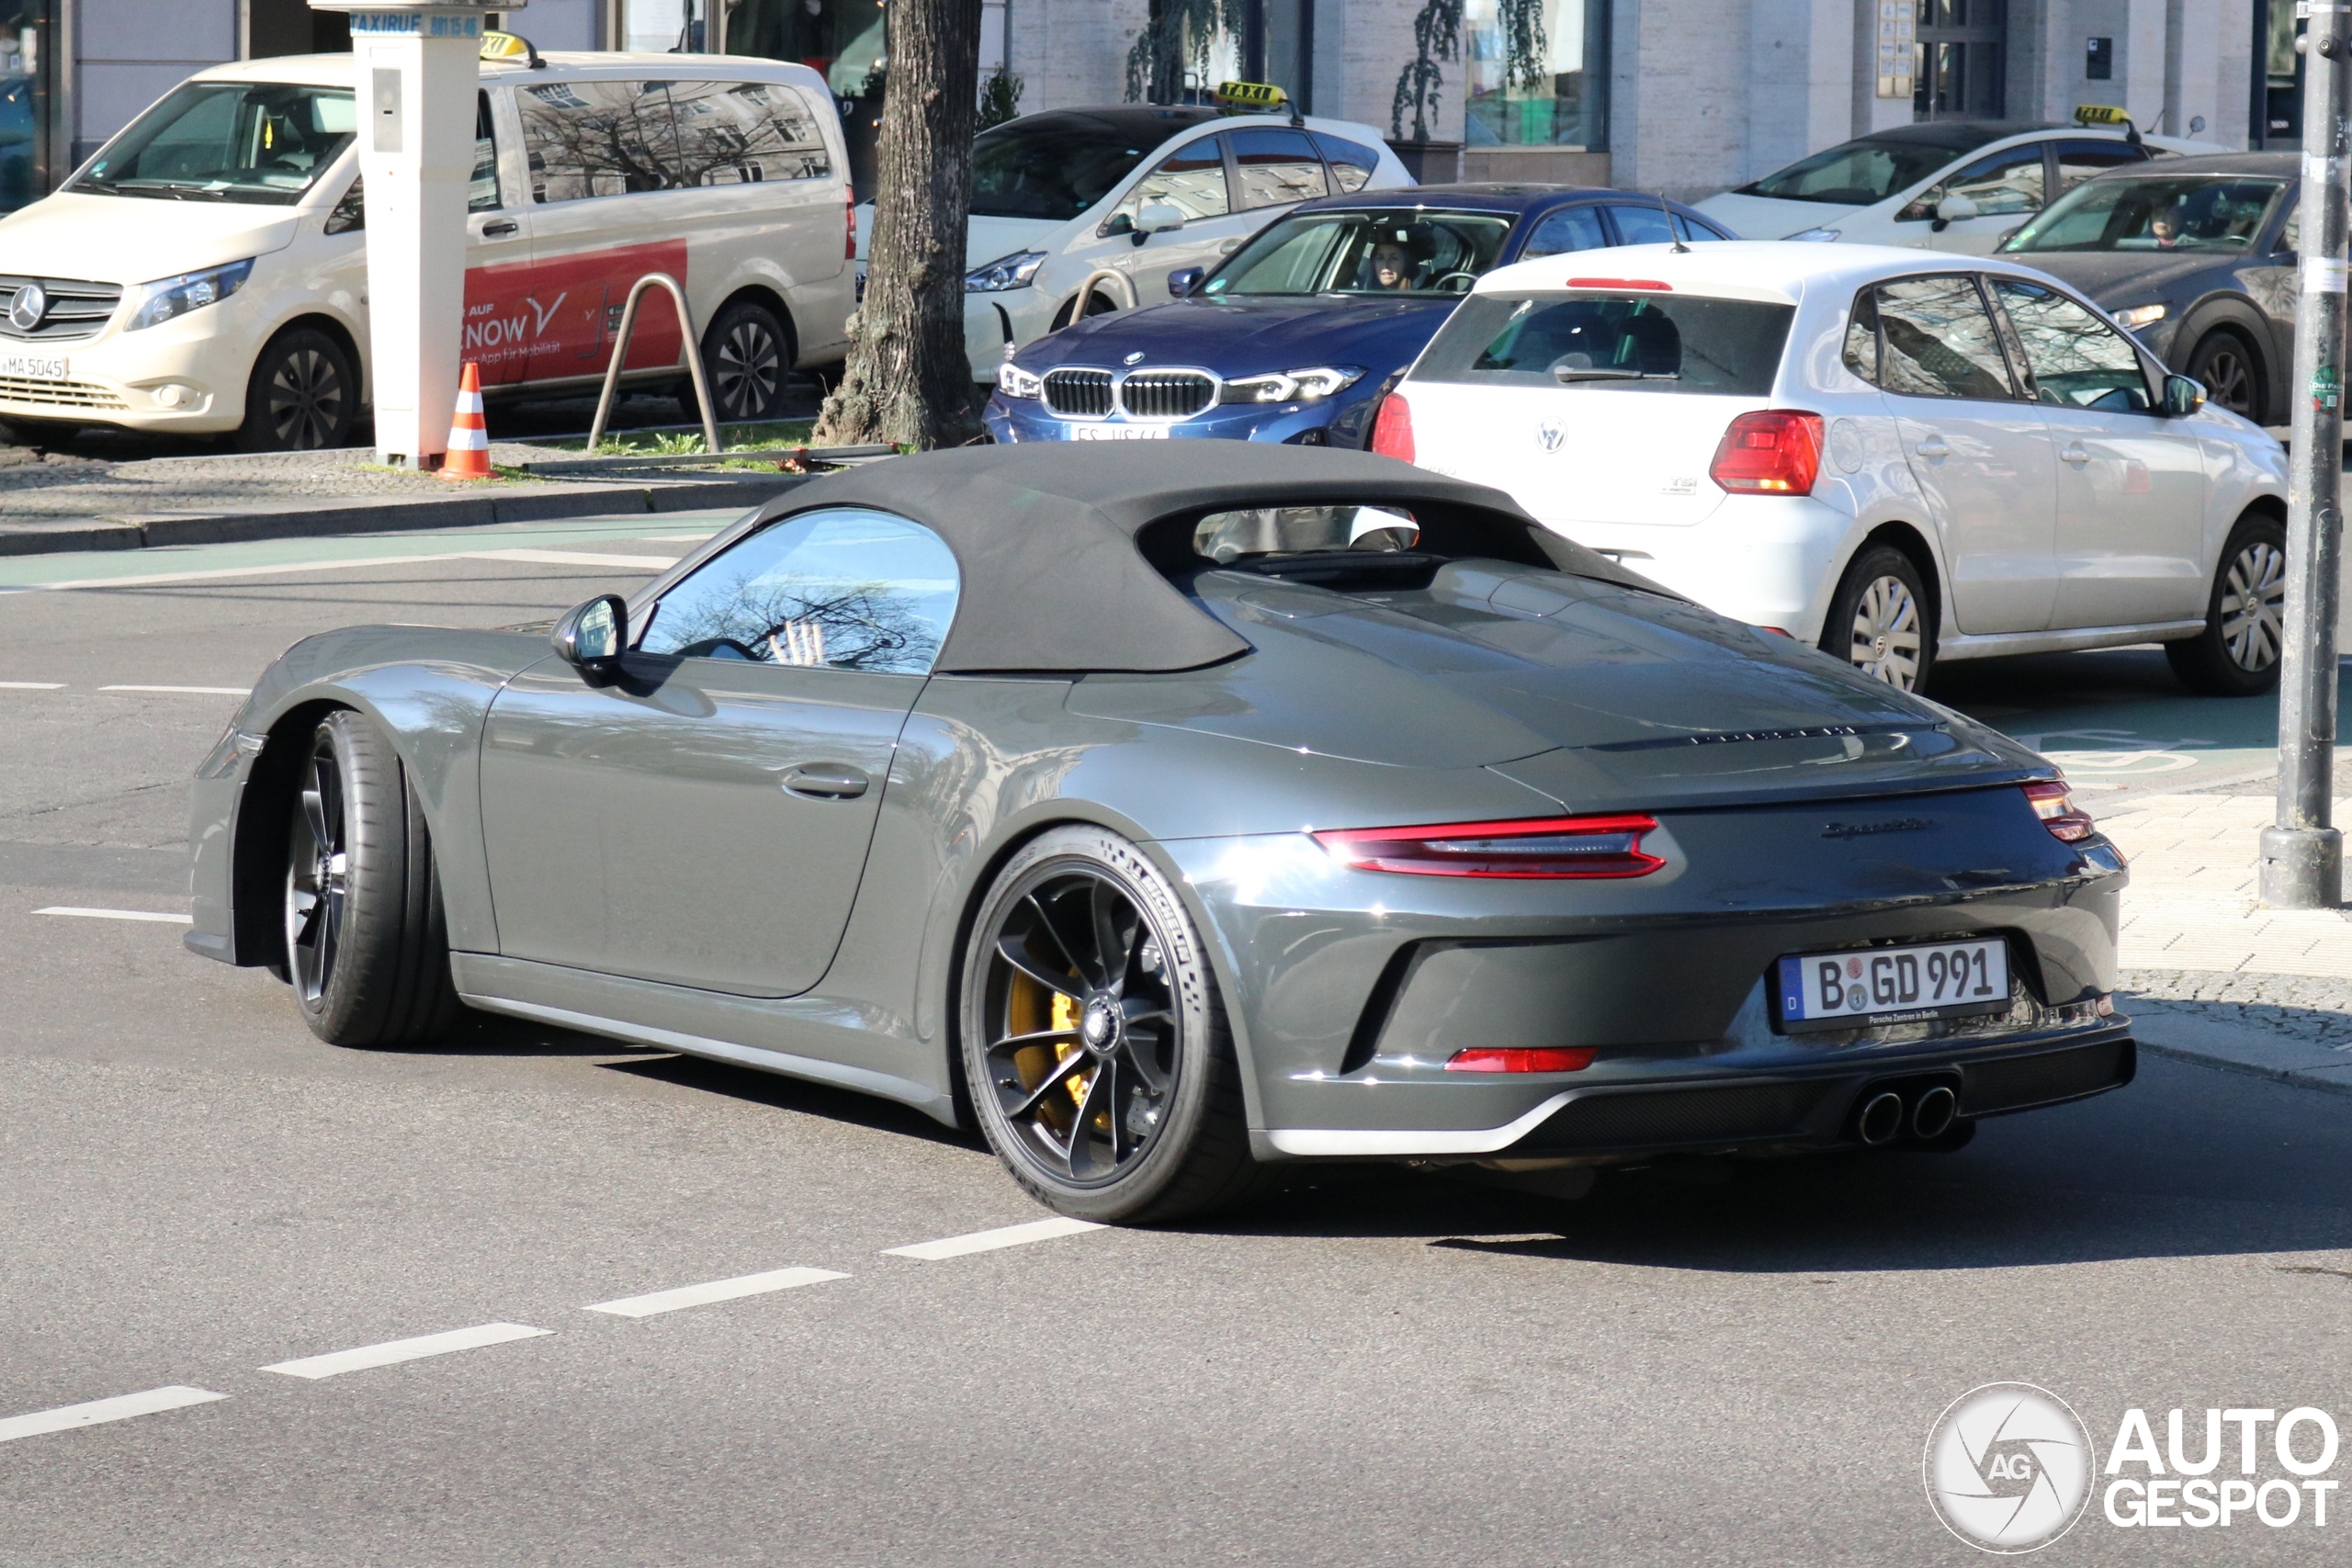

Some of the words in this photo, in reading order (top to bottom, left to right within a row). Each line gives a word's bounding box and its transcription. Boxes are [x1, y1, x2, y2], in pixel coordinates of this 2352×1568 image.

[1227, 84, 1265, 98] TAXI
[2081, 107, 2109, 118] TAXI
[469, 303, 494, 317] AUF
[461, 315, 527, 350] NOW
[518, 341, 561, 357] Mobilität
[8, 357, 25, 375] MA
[28, 358, 62, 378] 5045
[1141, 875, 1193, 966] MICHELIN
[1819, 961, 1845, 1010] B
[1871, 954, 1919, 1005] GD
[1928, 948, 1993, 1000] 991
[1788, 997, 1797, 1010] D
